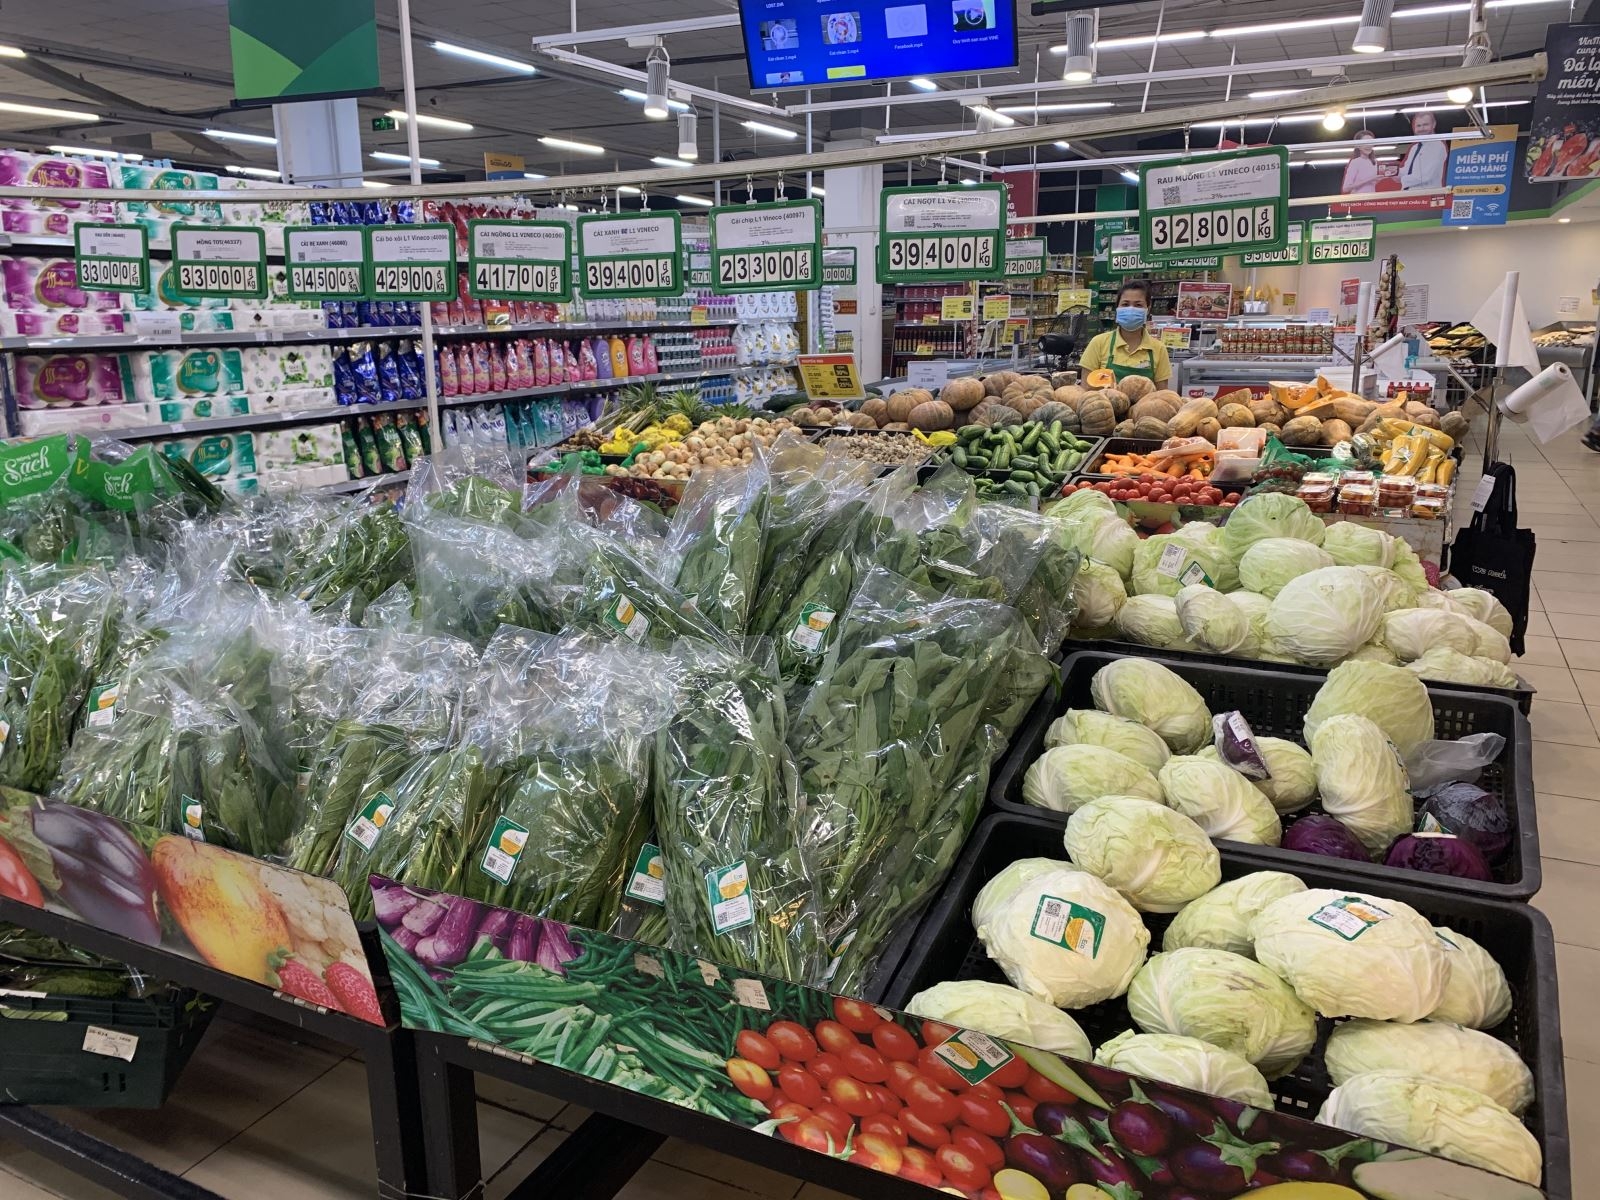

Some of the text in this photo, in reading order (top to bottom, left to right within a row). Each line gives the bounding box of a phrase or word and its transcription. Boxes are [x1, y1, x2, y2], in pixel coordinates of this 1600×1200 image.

[1564, 57, 1586, 72] Đá
[1558, 72, 1596, 89] miễn
[1456, 150, 1510, 164] MIỄN PHÍ
[1157, 176, 1173, 184] RAU
[1218, 166, 1250, 177] VINECO
[1455, 164, 1507, 174] GIAO HÀNG
[1154, 215, 1249, 244] 32.800
[892, 242, 972, 266] 39.400
[82, 263, 128, 282] 33.000
[182, 268, 241, 287] 33.000
[478, 267, 544, 289] 41.700
[589, 264, 654, 286] 39.400
[722, 255, 793, 282] 23.300
[294, 270, 346, 290] 34.500
[376, 270, 433, 290] 42.900
